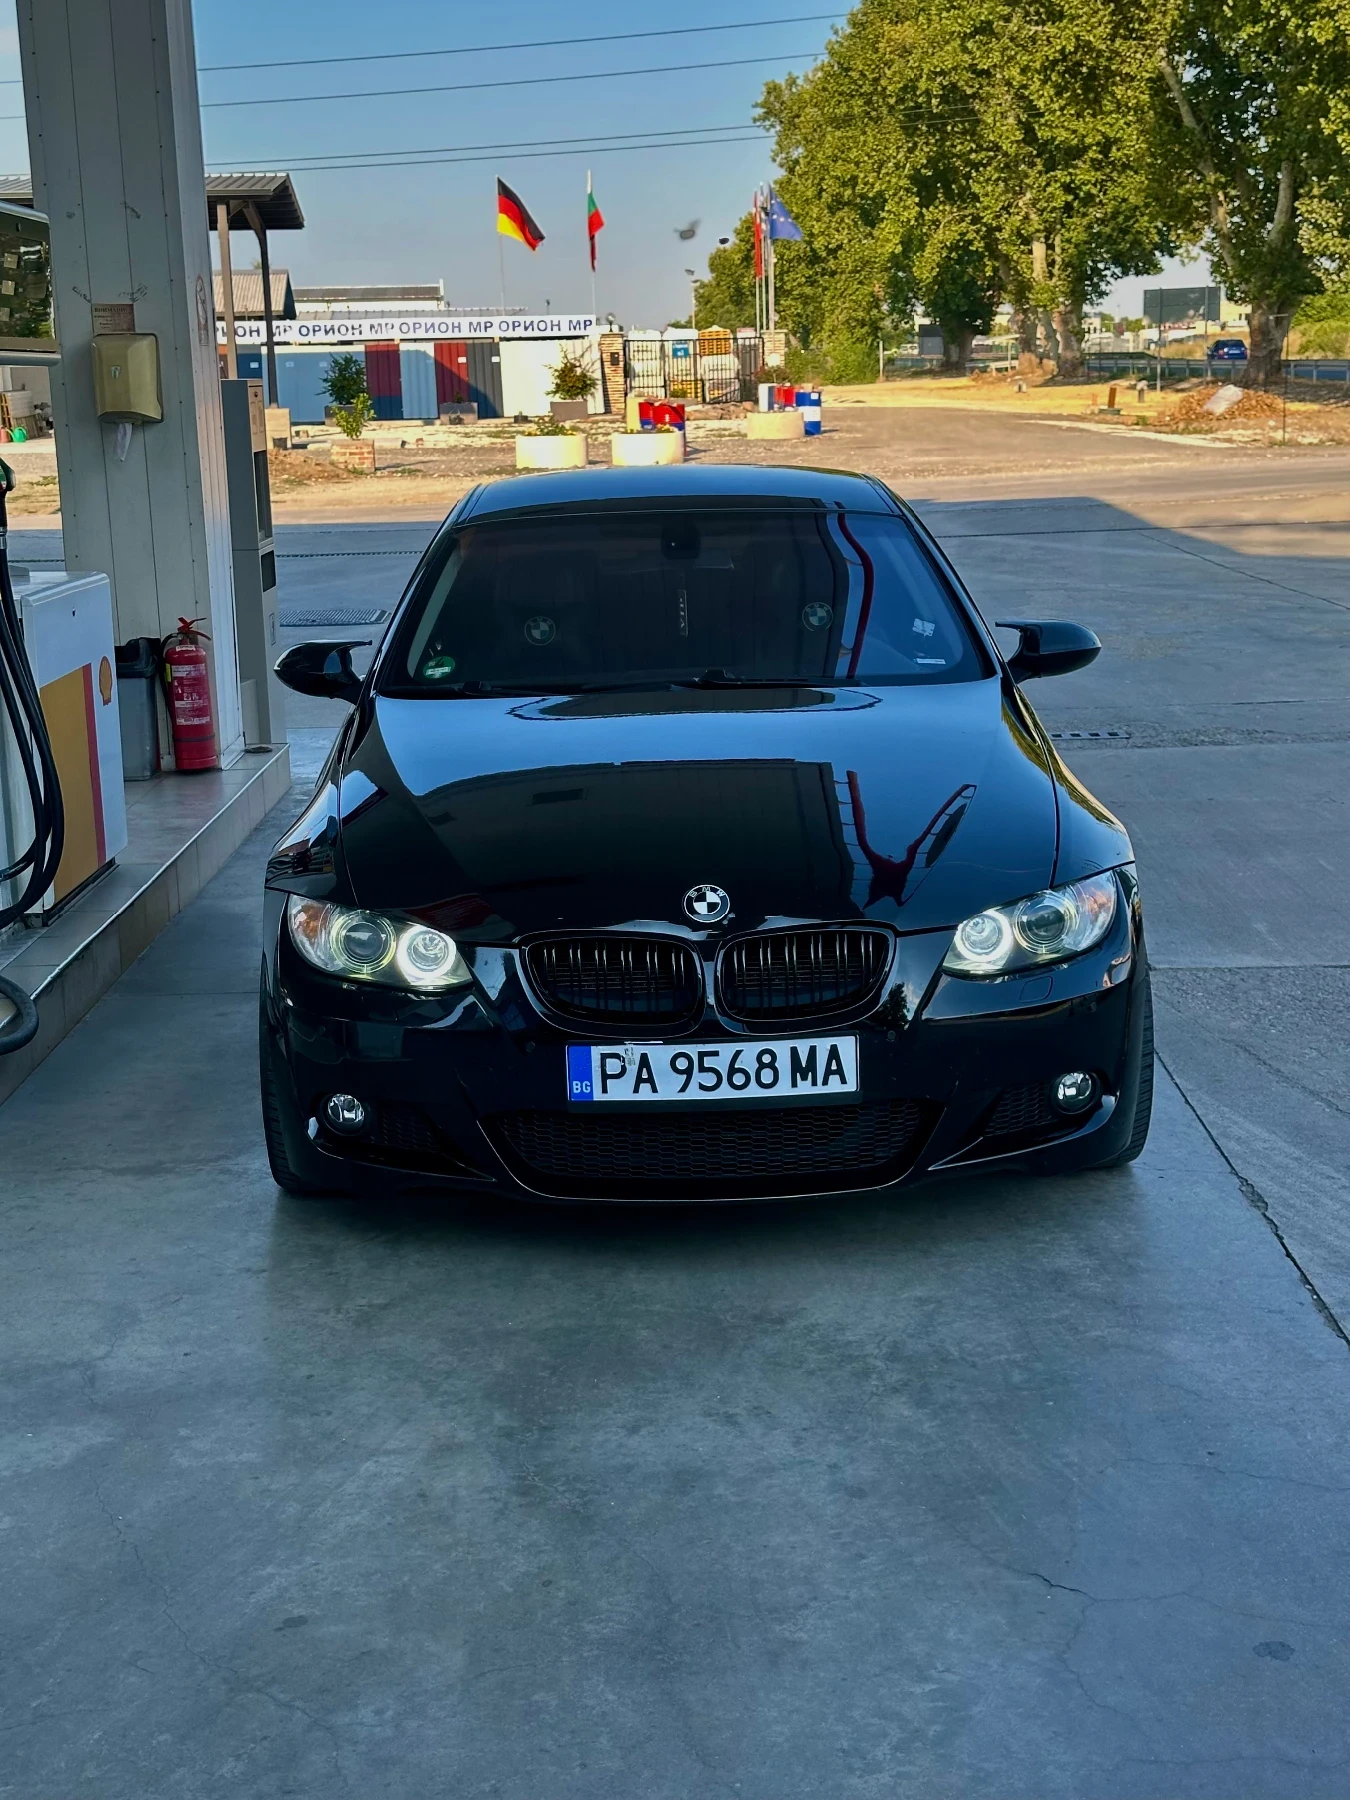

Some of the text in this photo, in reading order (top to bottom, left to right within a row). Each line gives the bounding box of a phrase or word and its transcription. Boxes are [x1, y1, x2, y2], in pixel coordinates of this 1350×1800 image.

[298, 323, 363, 338] ОРИОН
[369, 322, 395, 335] МР
[399, 321, 462, 335] ОРИОН
[468, 321, 494, 334] МР
[498, 319, 561, 333] ОРИОН
[568, 319, 593, 332] МР
[688, 886, 727, 898] BMW
[599, 1051, 659, 1095] PA
[669, 1047, 781, 1094] 9568
[789, 1043, 848, 1089] MA
[572, 1080, 591, 1094] BG
